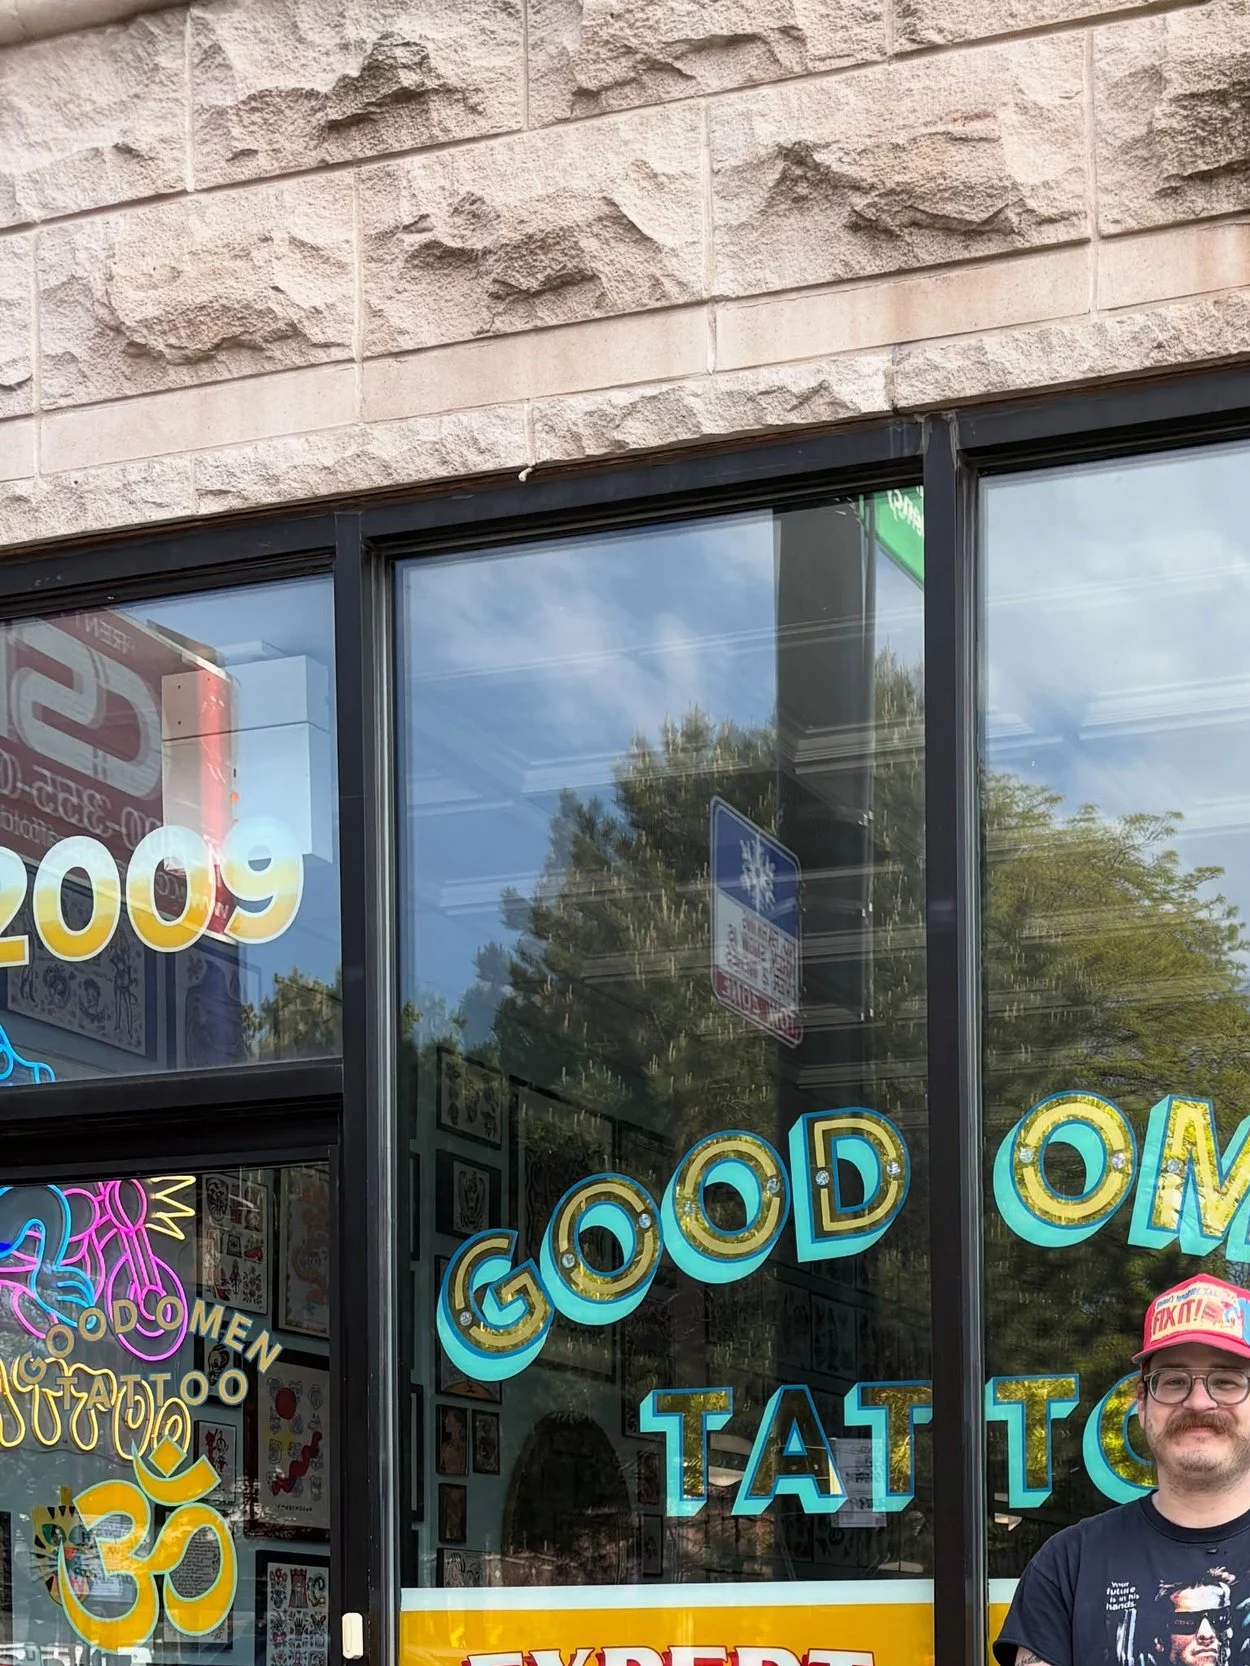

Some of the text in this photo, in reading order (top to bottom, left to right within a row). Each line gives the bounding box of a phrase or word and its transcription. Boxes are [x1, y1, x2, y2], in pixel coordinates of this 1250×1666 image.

[436, 1106, 912, 1382] GOOD
[18, 1295, 283, 1386] GOOD OMEN
[1152, 1304, 1176, 1335] FIX
[57, 1369, 249, 1412] TATTOO
